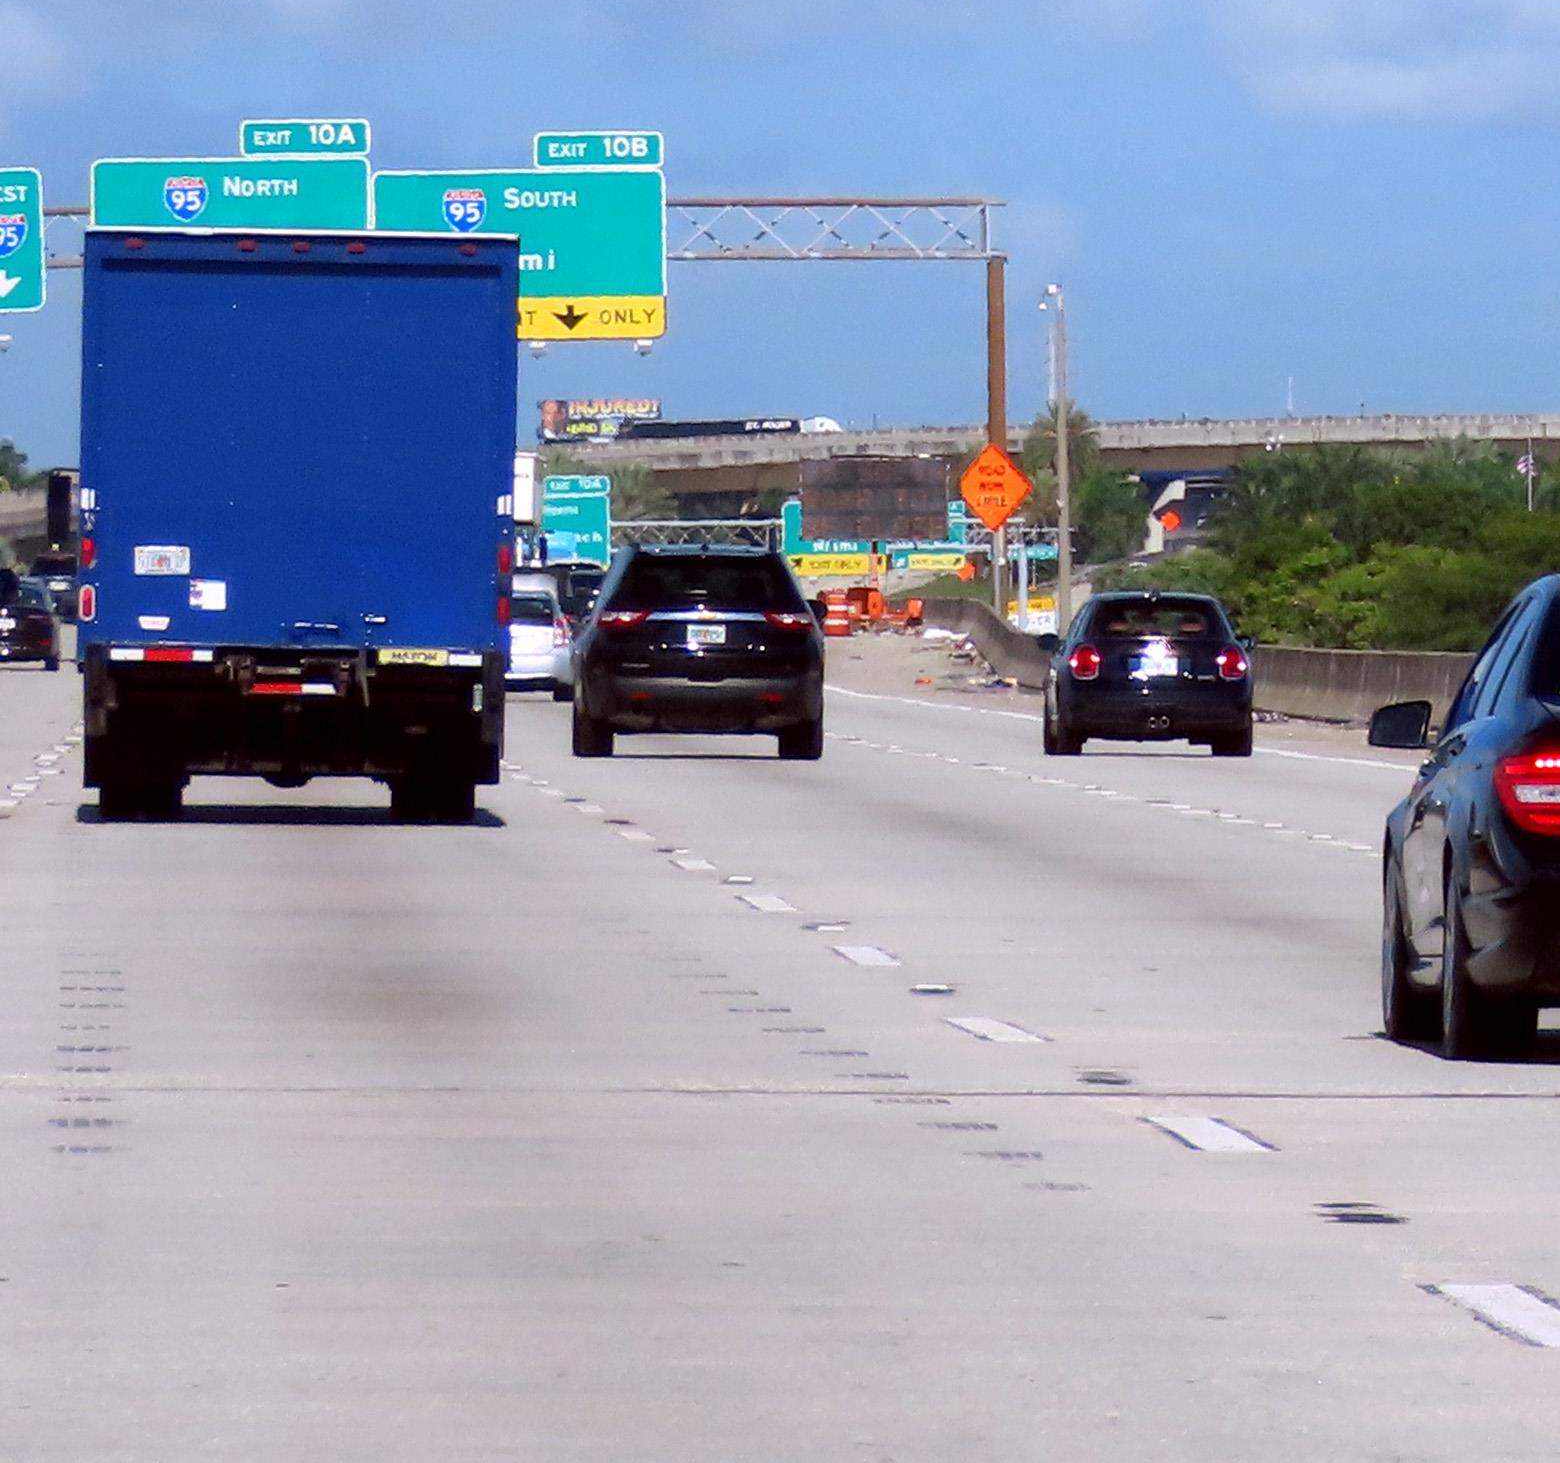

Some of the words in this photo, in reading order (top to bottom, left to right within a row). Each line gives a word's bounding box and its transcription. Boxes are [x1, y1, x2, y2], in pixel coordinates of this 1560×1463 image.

[253, 130, 292, 146] EXIT
[309, 124, 356, 145] 10A
[548, 142, 587, 158] EXIT
[603, 137, 648, 158] 10B
[171, 190, 201, 212] 95
[449, 202, 481, 223] 95
[600, 308, 656, 325] ONLY
